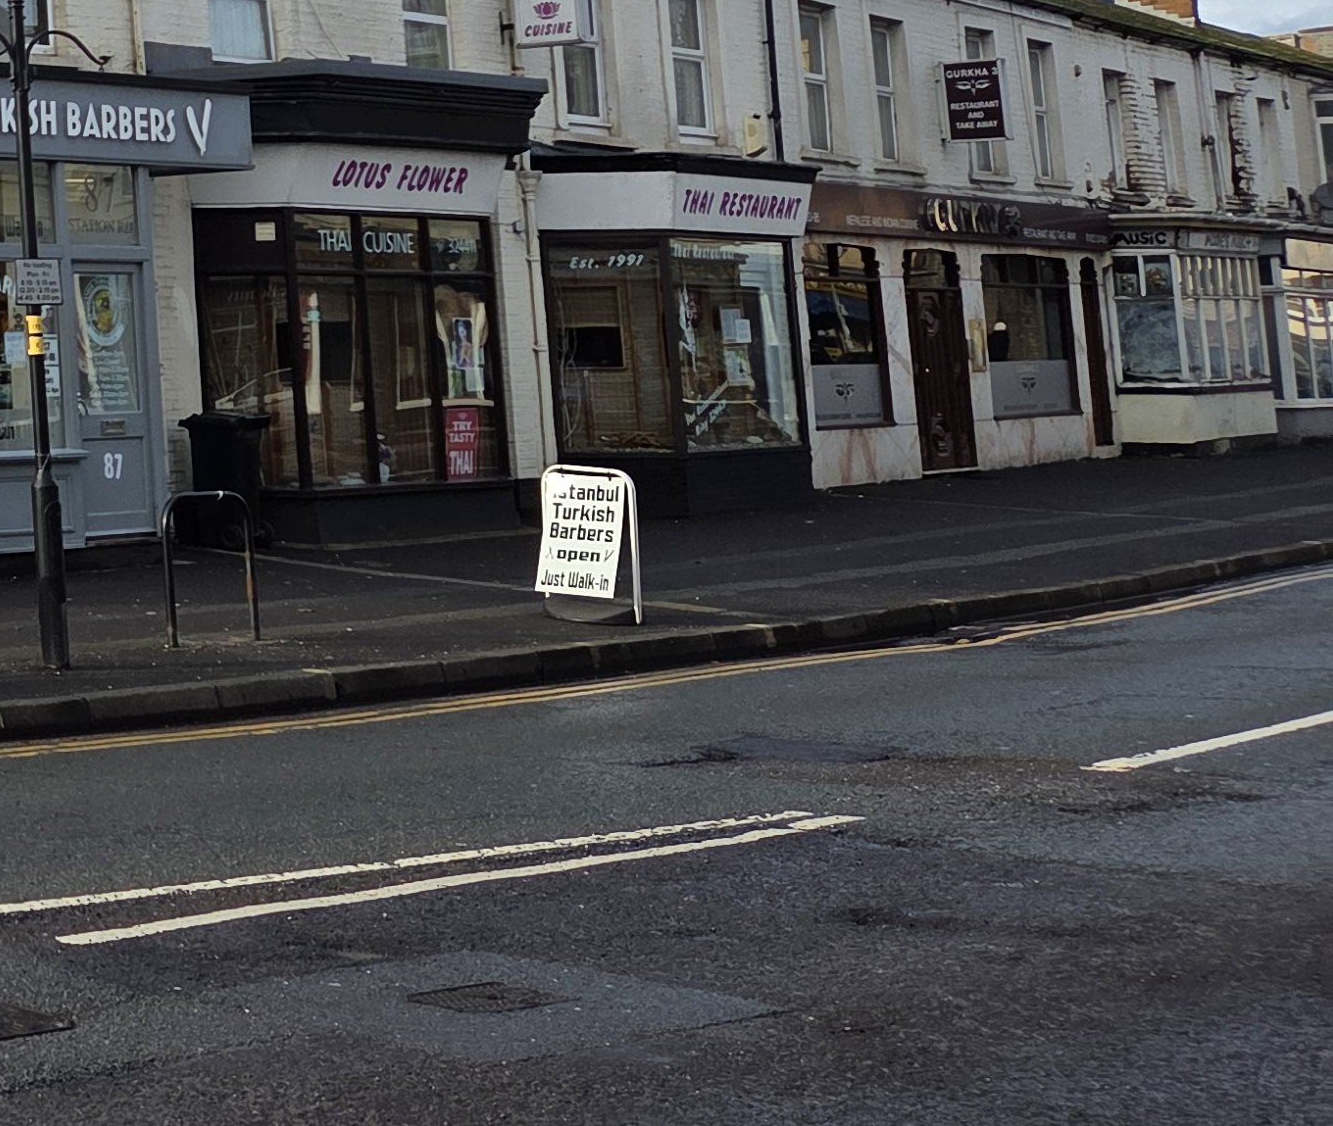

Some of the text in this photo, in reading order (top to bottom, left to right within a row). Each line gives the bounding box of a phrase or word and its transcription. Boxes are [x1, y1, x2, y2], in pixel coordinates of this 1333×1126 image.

[524, 21, 573, 37] CUISINE
[945, 66, 998, 79] GURKHA 3
[67, 101, 176, 143] BARBERS
[967, 111, 985, 119] AND
[332, 159, 469, 195] LOTUS FLOWER
[683, 188, 715, 216] THAI
[719, 191, 803, 221] RESTAURANT
[317, 229, 352, 252] THAI
[362, 231, 416, 254] CUISINE
[569, 254, 644, 270] Est. 1991
[452, 421, 472, 431] TRY
[448, 432, 475, 443] TASTY
[103, 452, 123, 479] 87
[449, 449, 473, 475] THAI
[553, 484, 620, 502] tanbul
[552, 502, 615, 522] Turkish
[549, 522, 614, 542] Barbers
[557, 549, 600, 562] open
[541, 569, 609, 591] Just Walk-in
